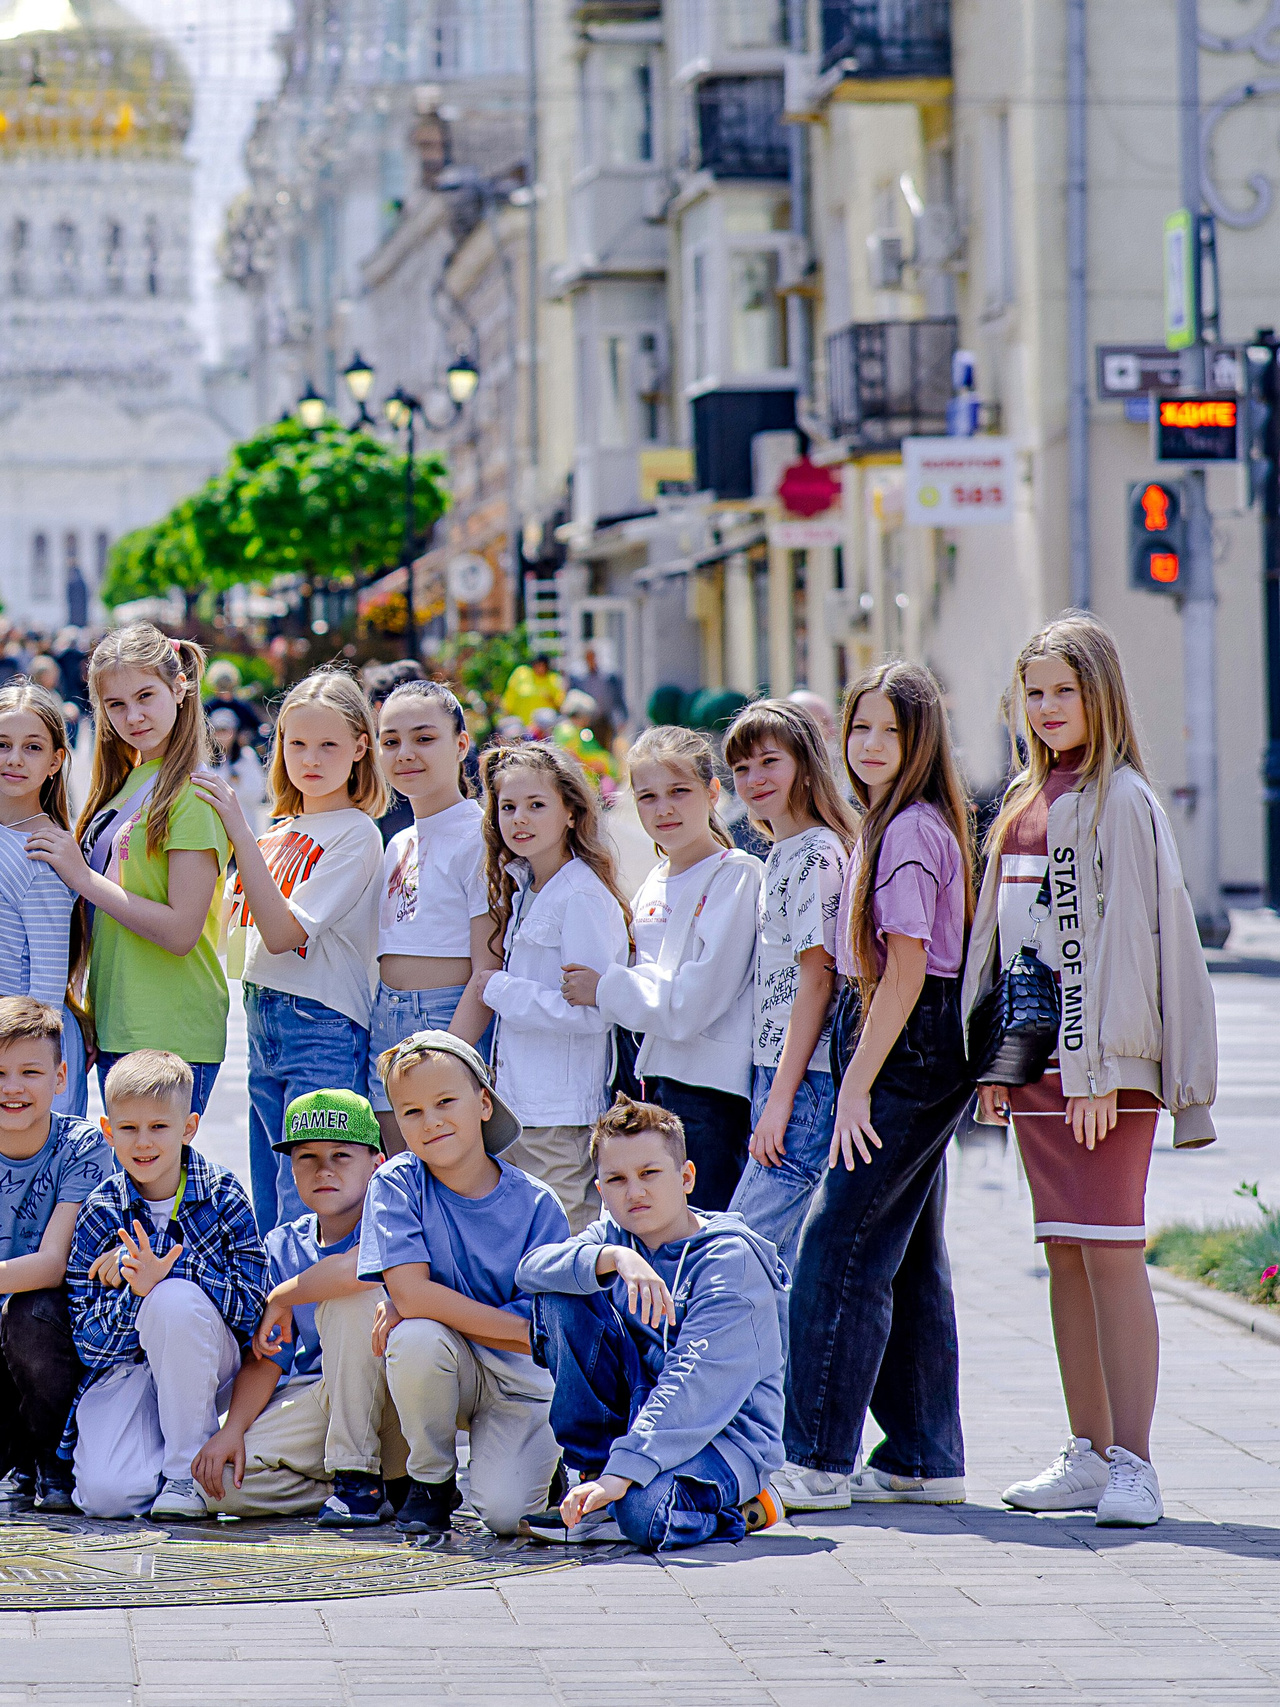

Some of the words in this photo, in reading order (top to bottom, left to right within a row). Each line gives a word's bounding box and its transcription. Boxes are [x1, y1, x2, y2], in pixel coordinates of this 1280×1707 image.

[1159, 401, 1237, 428] ЖДИТЕ
[1053, 847, 1079, 931] STATE
[1061, 939, 1082, 975] OF
[765, 970, 780, 988] WE
[778, 964, 800, 982] ARE
[773, 978, 792, 995] NEW
[1064, 984, 1084, 1051] MIND
[291, 1109, 348, 1133] GAMER
